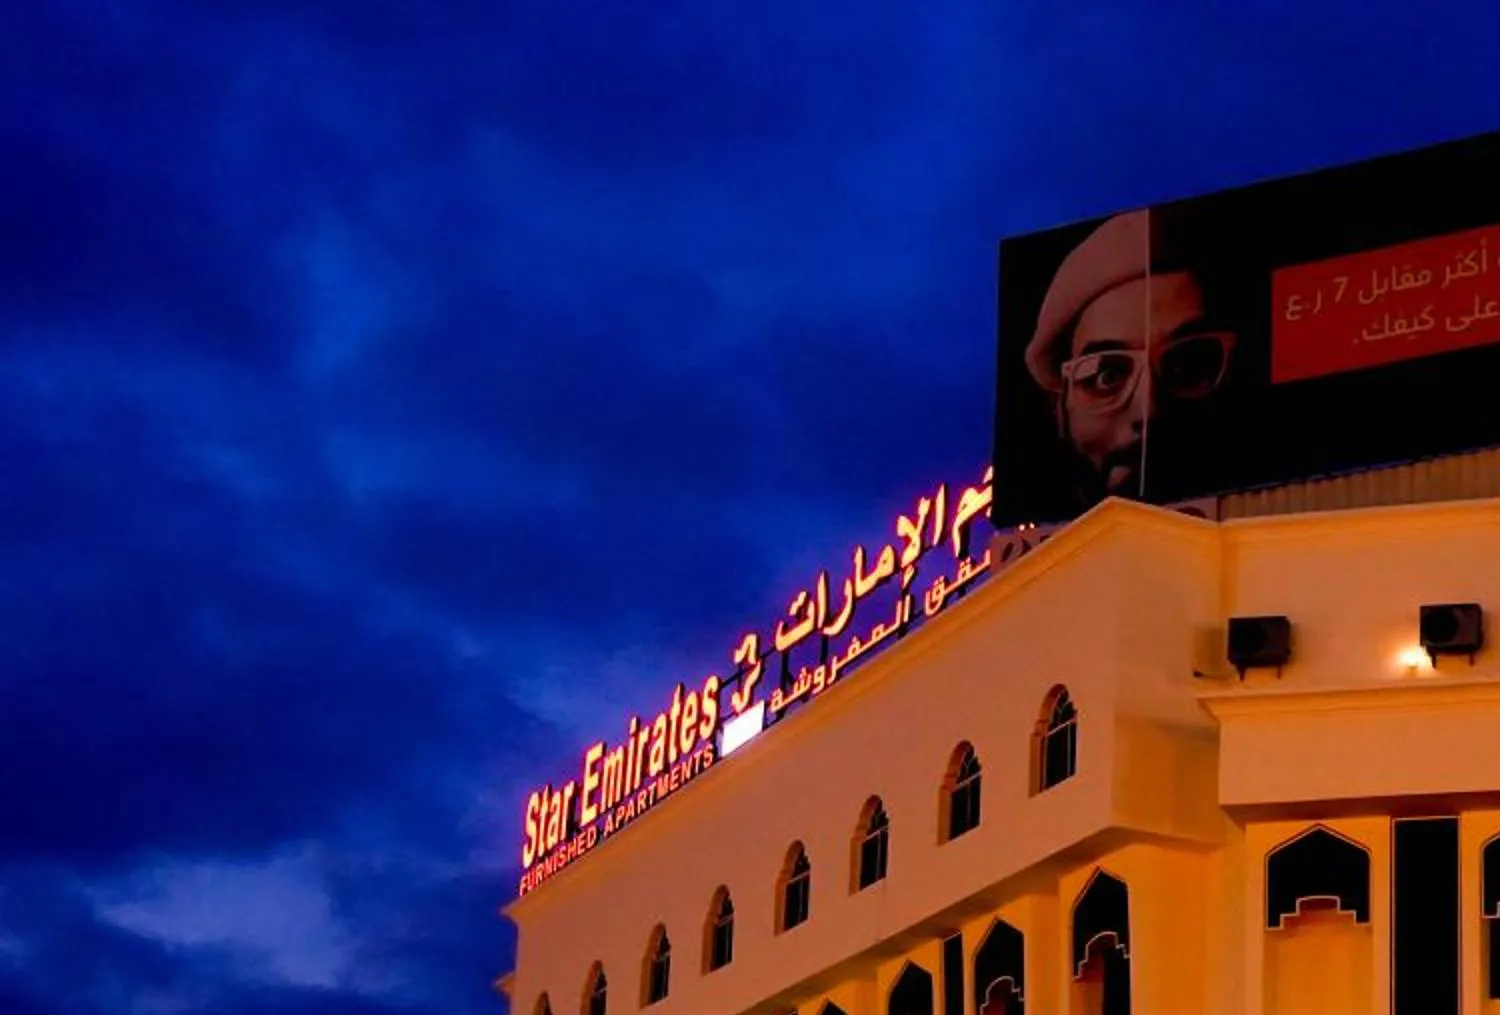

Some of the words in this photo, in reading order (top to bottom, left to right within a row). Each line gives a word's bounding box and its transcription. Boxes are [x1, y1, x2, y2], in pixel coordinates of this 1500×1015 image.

[1333, 276, 1349, 303] 7
[1357, 266, 1432, 305] مقابل
[1440, 237, 1489, 292] أكثر
[1445, 294, 1500, 331] على
[775, 483, 948, 652] الإمارات
[770, 594, 912, 713] المفروشة
[522, 784, 575, 869] Star
[580, 675, 719, 827] Emirates
[519, 825, 598, 897] FURNISHED
[603, 744, 714, 836] APARTMENTS
